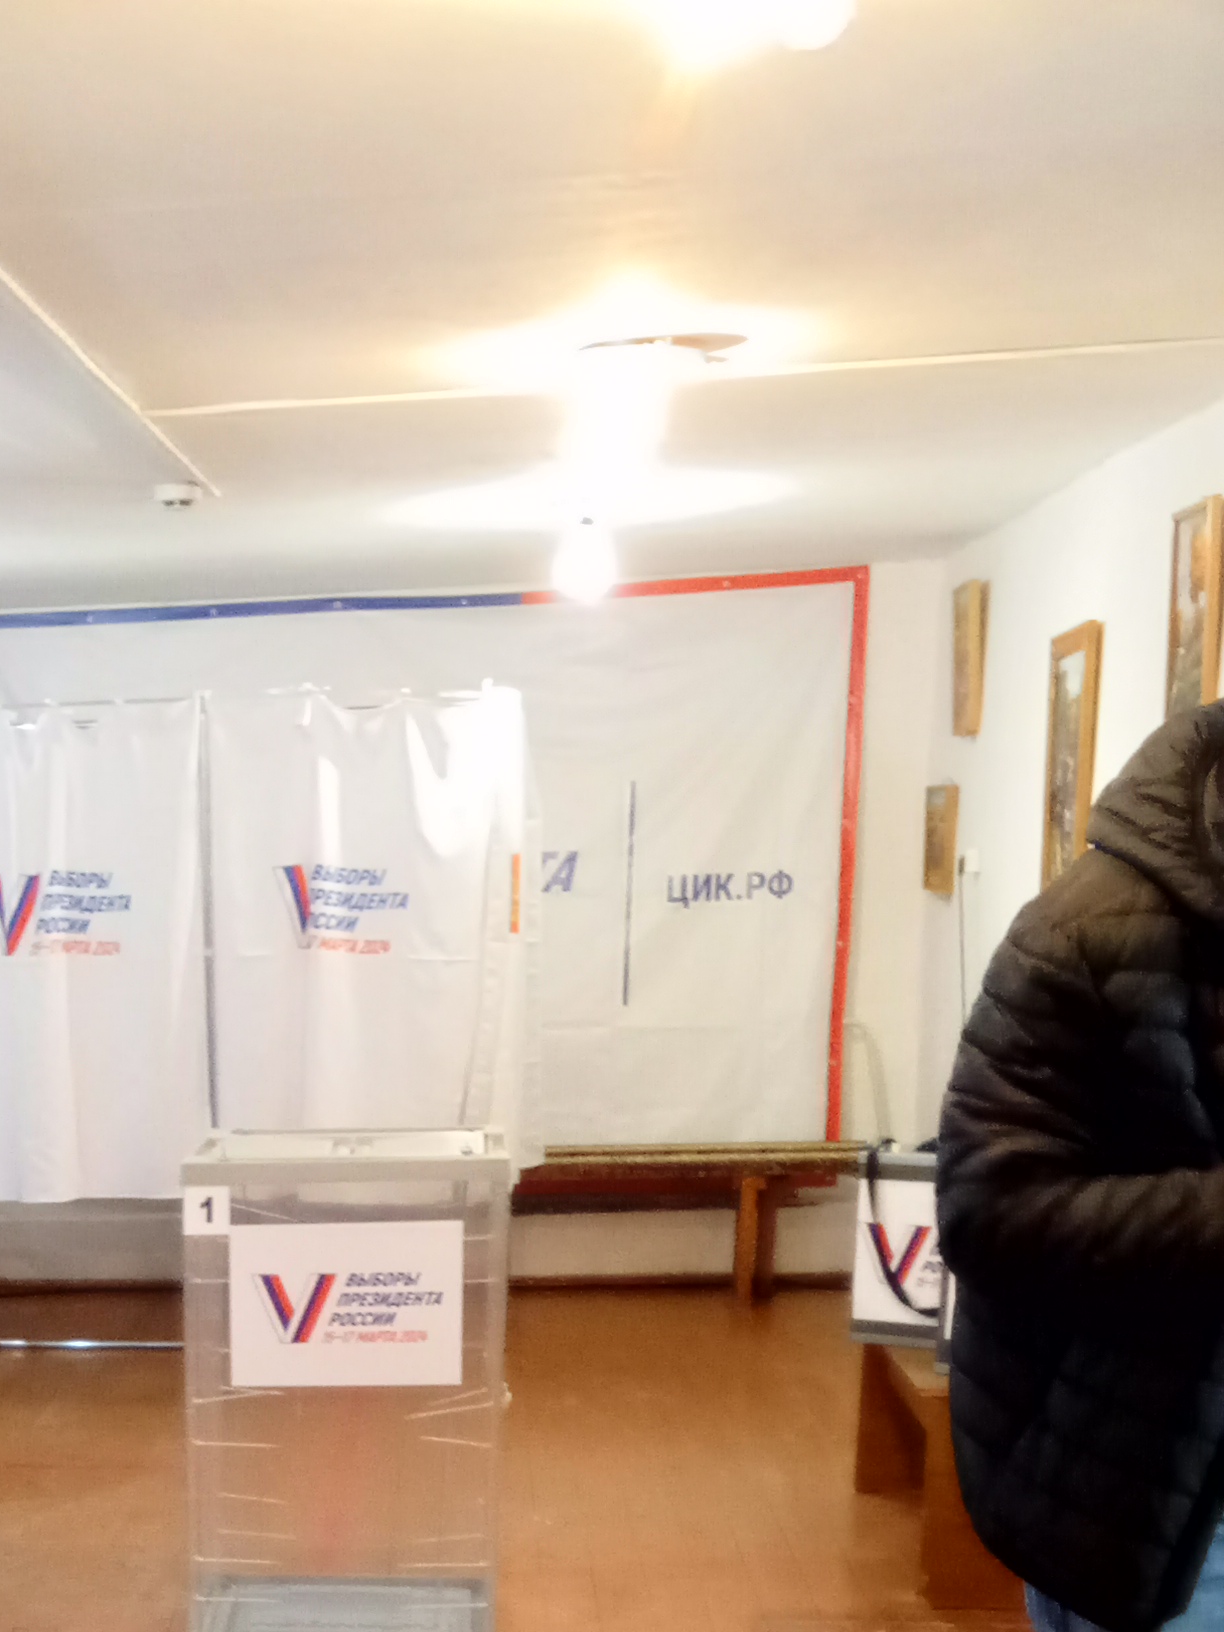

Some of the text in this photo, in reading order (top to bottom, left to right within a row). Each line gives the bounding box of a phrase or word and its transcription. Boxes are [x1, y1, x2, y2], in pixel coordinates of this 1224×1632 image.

[311, 864, 387, 886] ВЫБОРЫ
[666, 870, 794, 908] ЦИК.РФ
[309, 912, 359, 933] ССИИ
[200, 1197, 214, 1223] 1
[345, 1272, 422, 1287] ВЫБОРЫ
[336, 1291, 444, 1308] ПРЕЗИДЕНТА
[328, 1312, 398, 1327] РОССИИ
